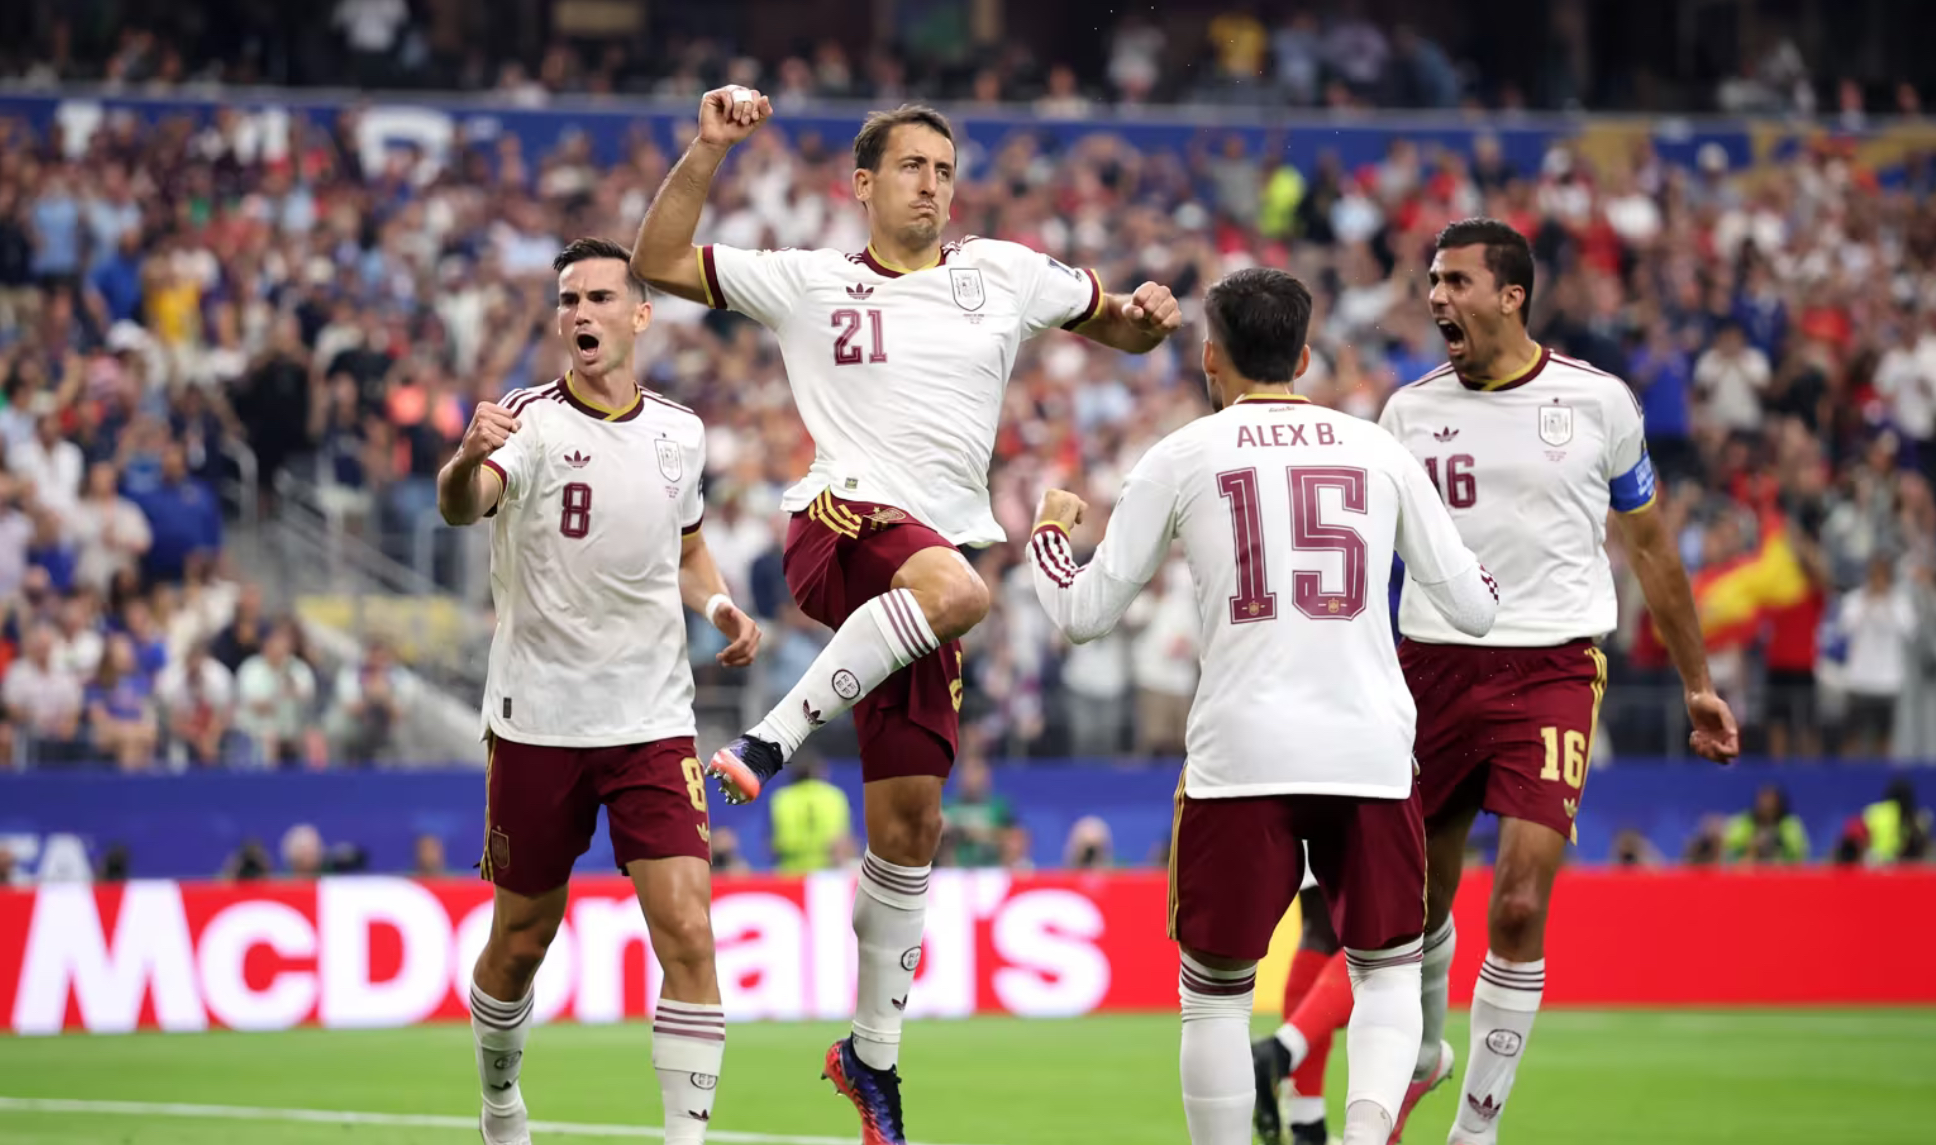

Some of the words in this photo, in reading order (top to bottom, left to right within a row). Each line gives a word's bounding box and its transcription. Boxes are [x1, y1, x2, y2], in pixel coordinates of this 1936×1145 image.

[831, 309, 887, 366] 21
[1237, 423, 1309, 448] ALEX
[1315, 422, 1343, 446] B.
[560, 482, 592, 539] 8
[1216, 465, 1368, 624] 15
[681, 757, 706, 813] 8
[1540, 727, 1586, 789] 16
